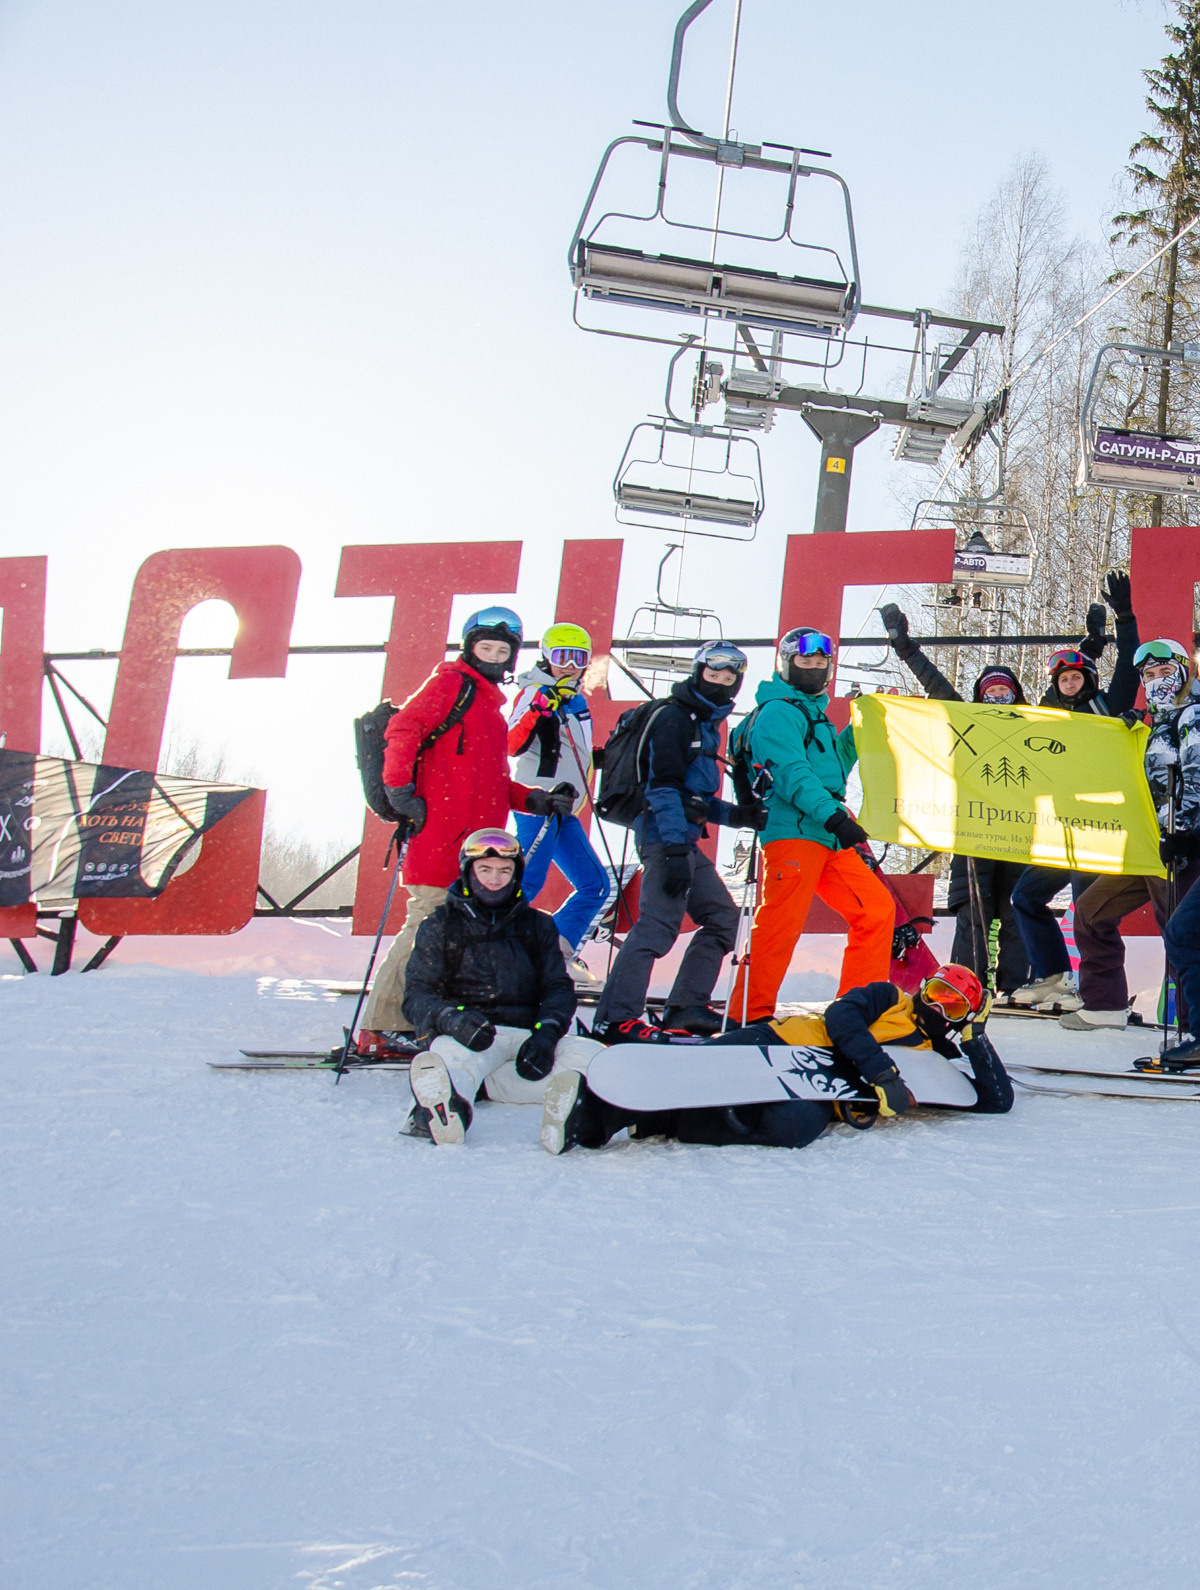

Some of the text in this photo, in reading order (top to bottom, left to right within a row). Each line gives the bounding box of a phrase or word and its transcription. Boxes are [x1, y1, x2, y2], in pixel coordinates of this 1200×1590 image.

[832, 460, 840, 470] 4
[78, 814, 119, 828] ХОТЬ
[891, 797, 959, 819] Время
[967, 800, 1123, 836] Приключений
